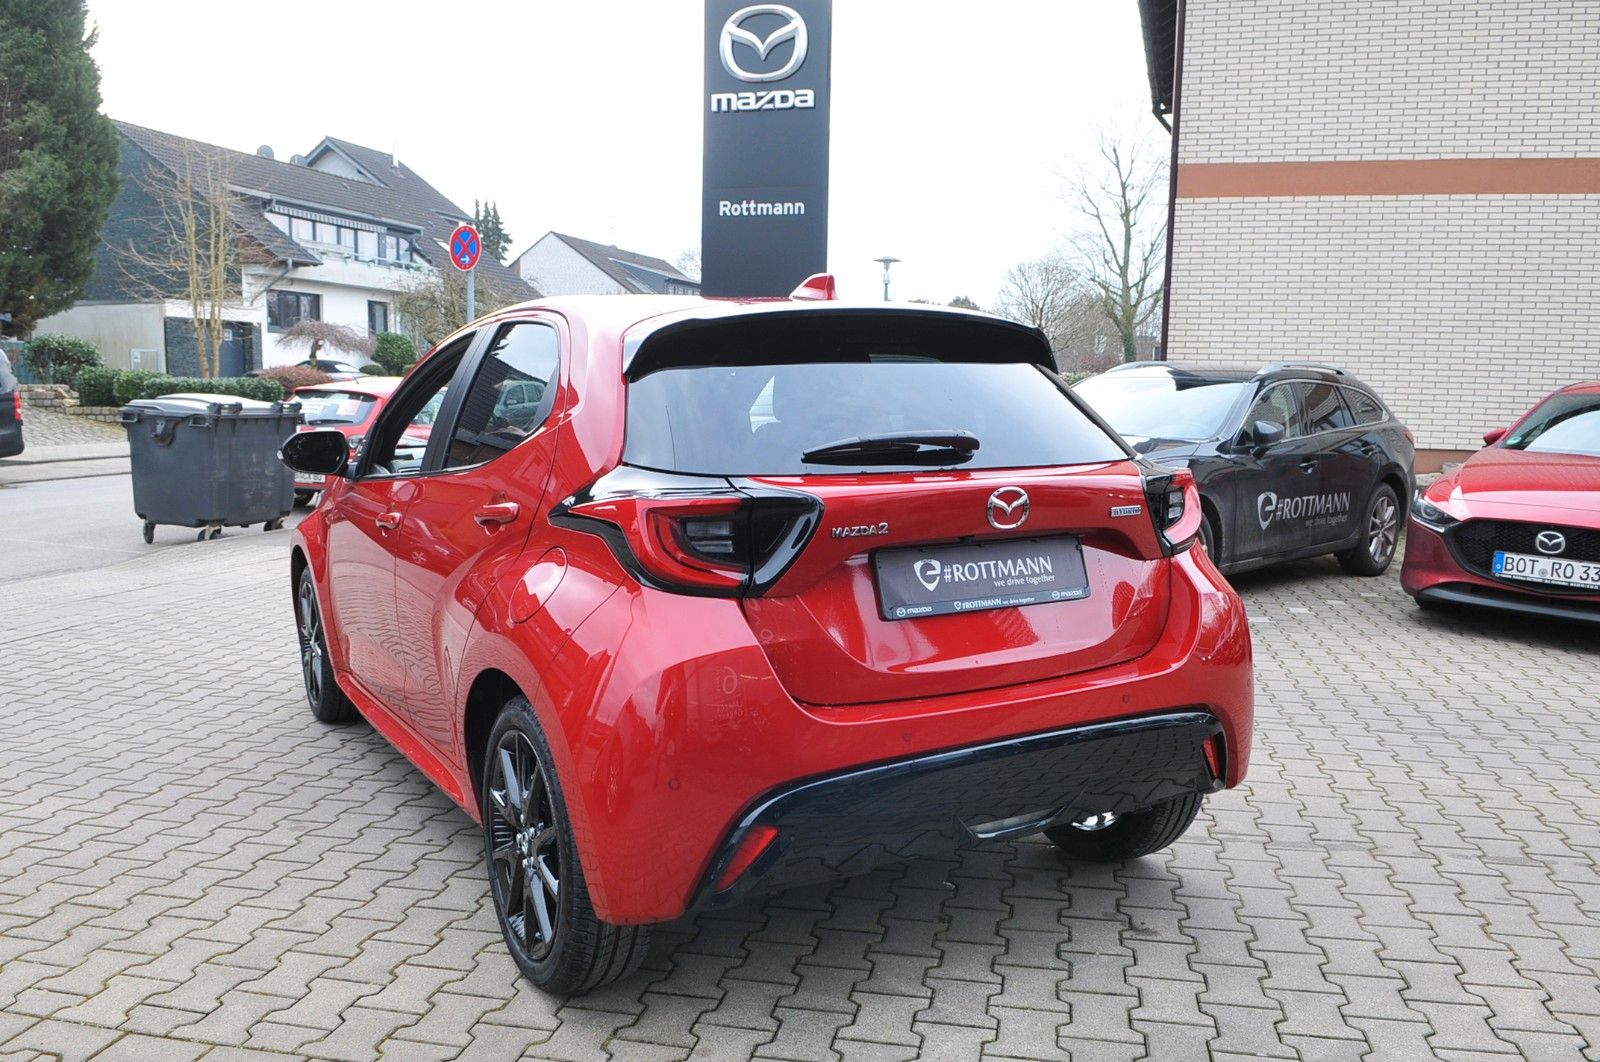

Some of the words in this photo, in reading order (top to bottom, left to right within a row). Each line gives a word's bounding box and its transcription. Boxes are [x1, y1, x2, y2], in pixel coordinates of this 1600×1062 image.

[711, 89, 815, 112] mazda
[719, 200, 805, 216] Rottmann
[943, 555, 1053, 583] #ROTTMANN
[1504, 556, 1540, 575] BOT
[1551, 562, 1575, 580] RO
[993, 580, 1006, 588] we
[1006, 576, 1025, 587] drive
[1026, 573, 1056, 586] together
